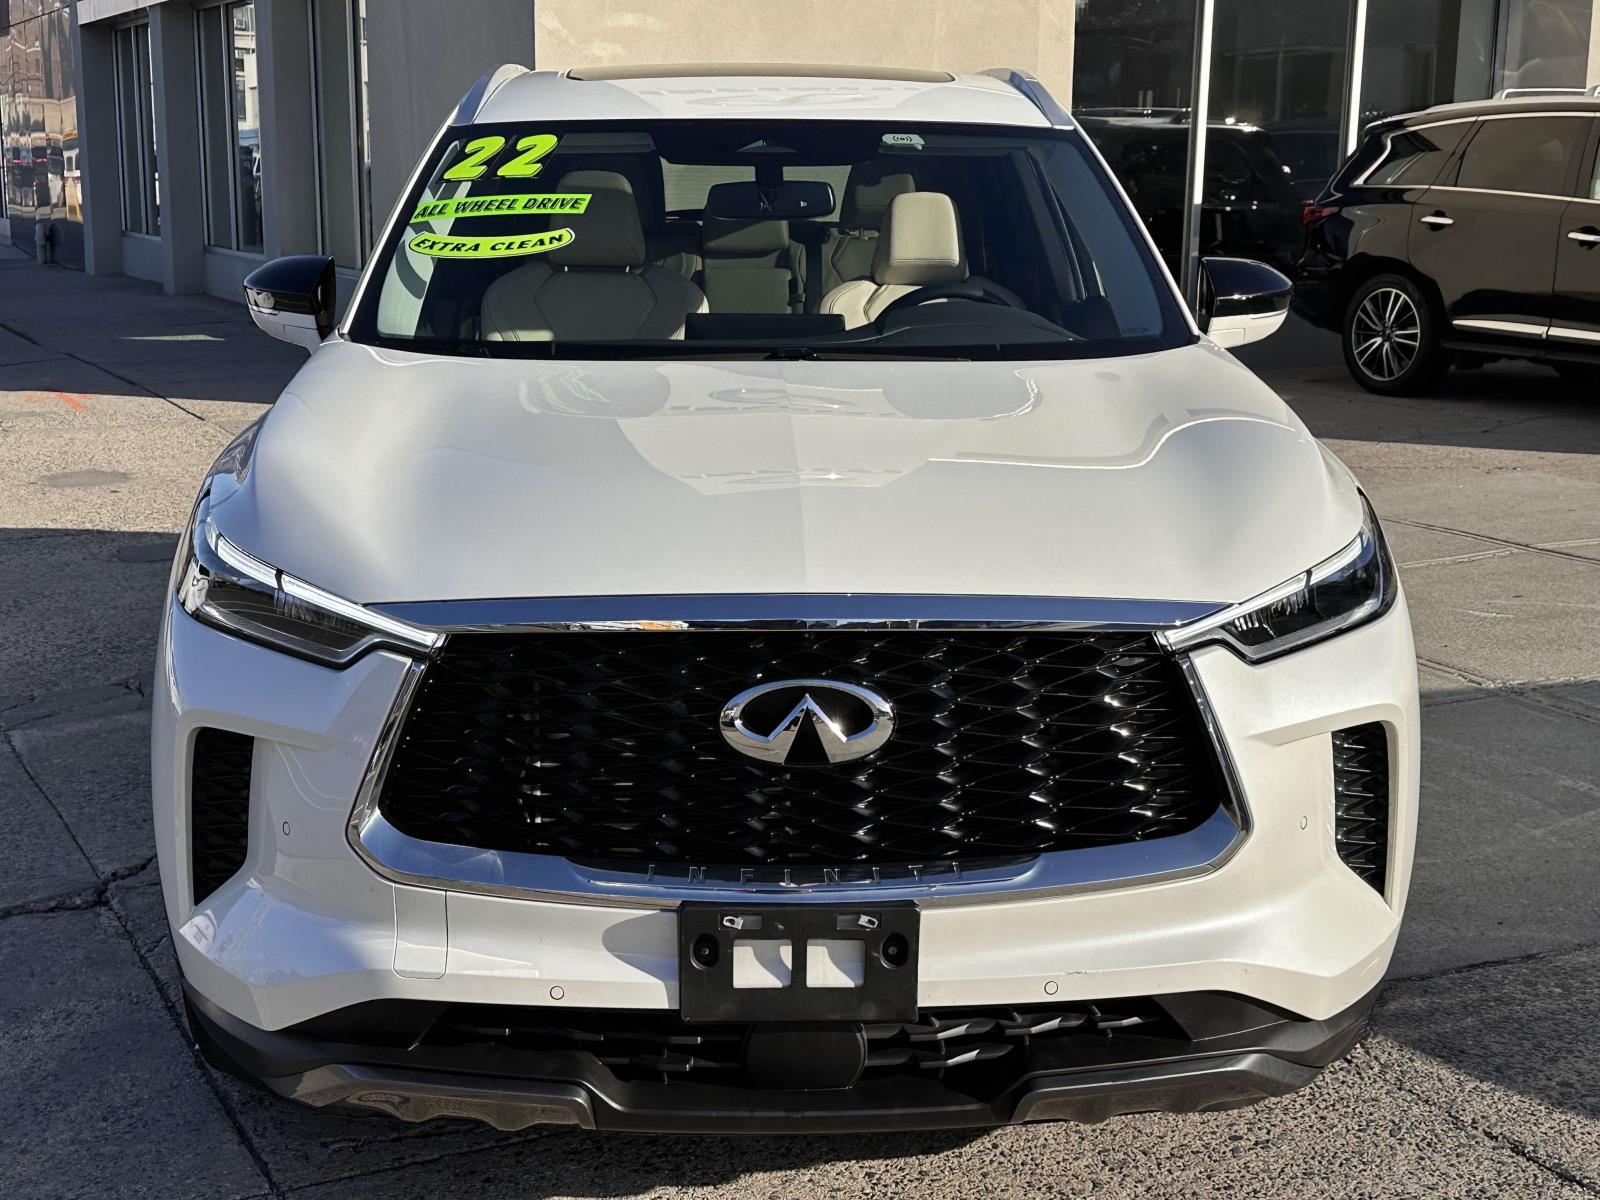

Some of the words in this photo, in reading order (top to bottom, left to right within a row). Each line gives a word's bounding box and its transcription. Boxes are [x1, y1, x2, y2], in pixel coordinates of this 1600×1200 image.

[443, 134, 558, 181] 22
[413, 203, 448, 219] ALL
[454, 198, 517, 214] WHEEL
[522, 197, 586, 210] DRIVE
[414, 238, 480, 253] EXTRA
[490, 234, 565, 251] CLEAN
[646, 861, 963, 887] INFINITI
